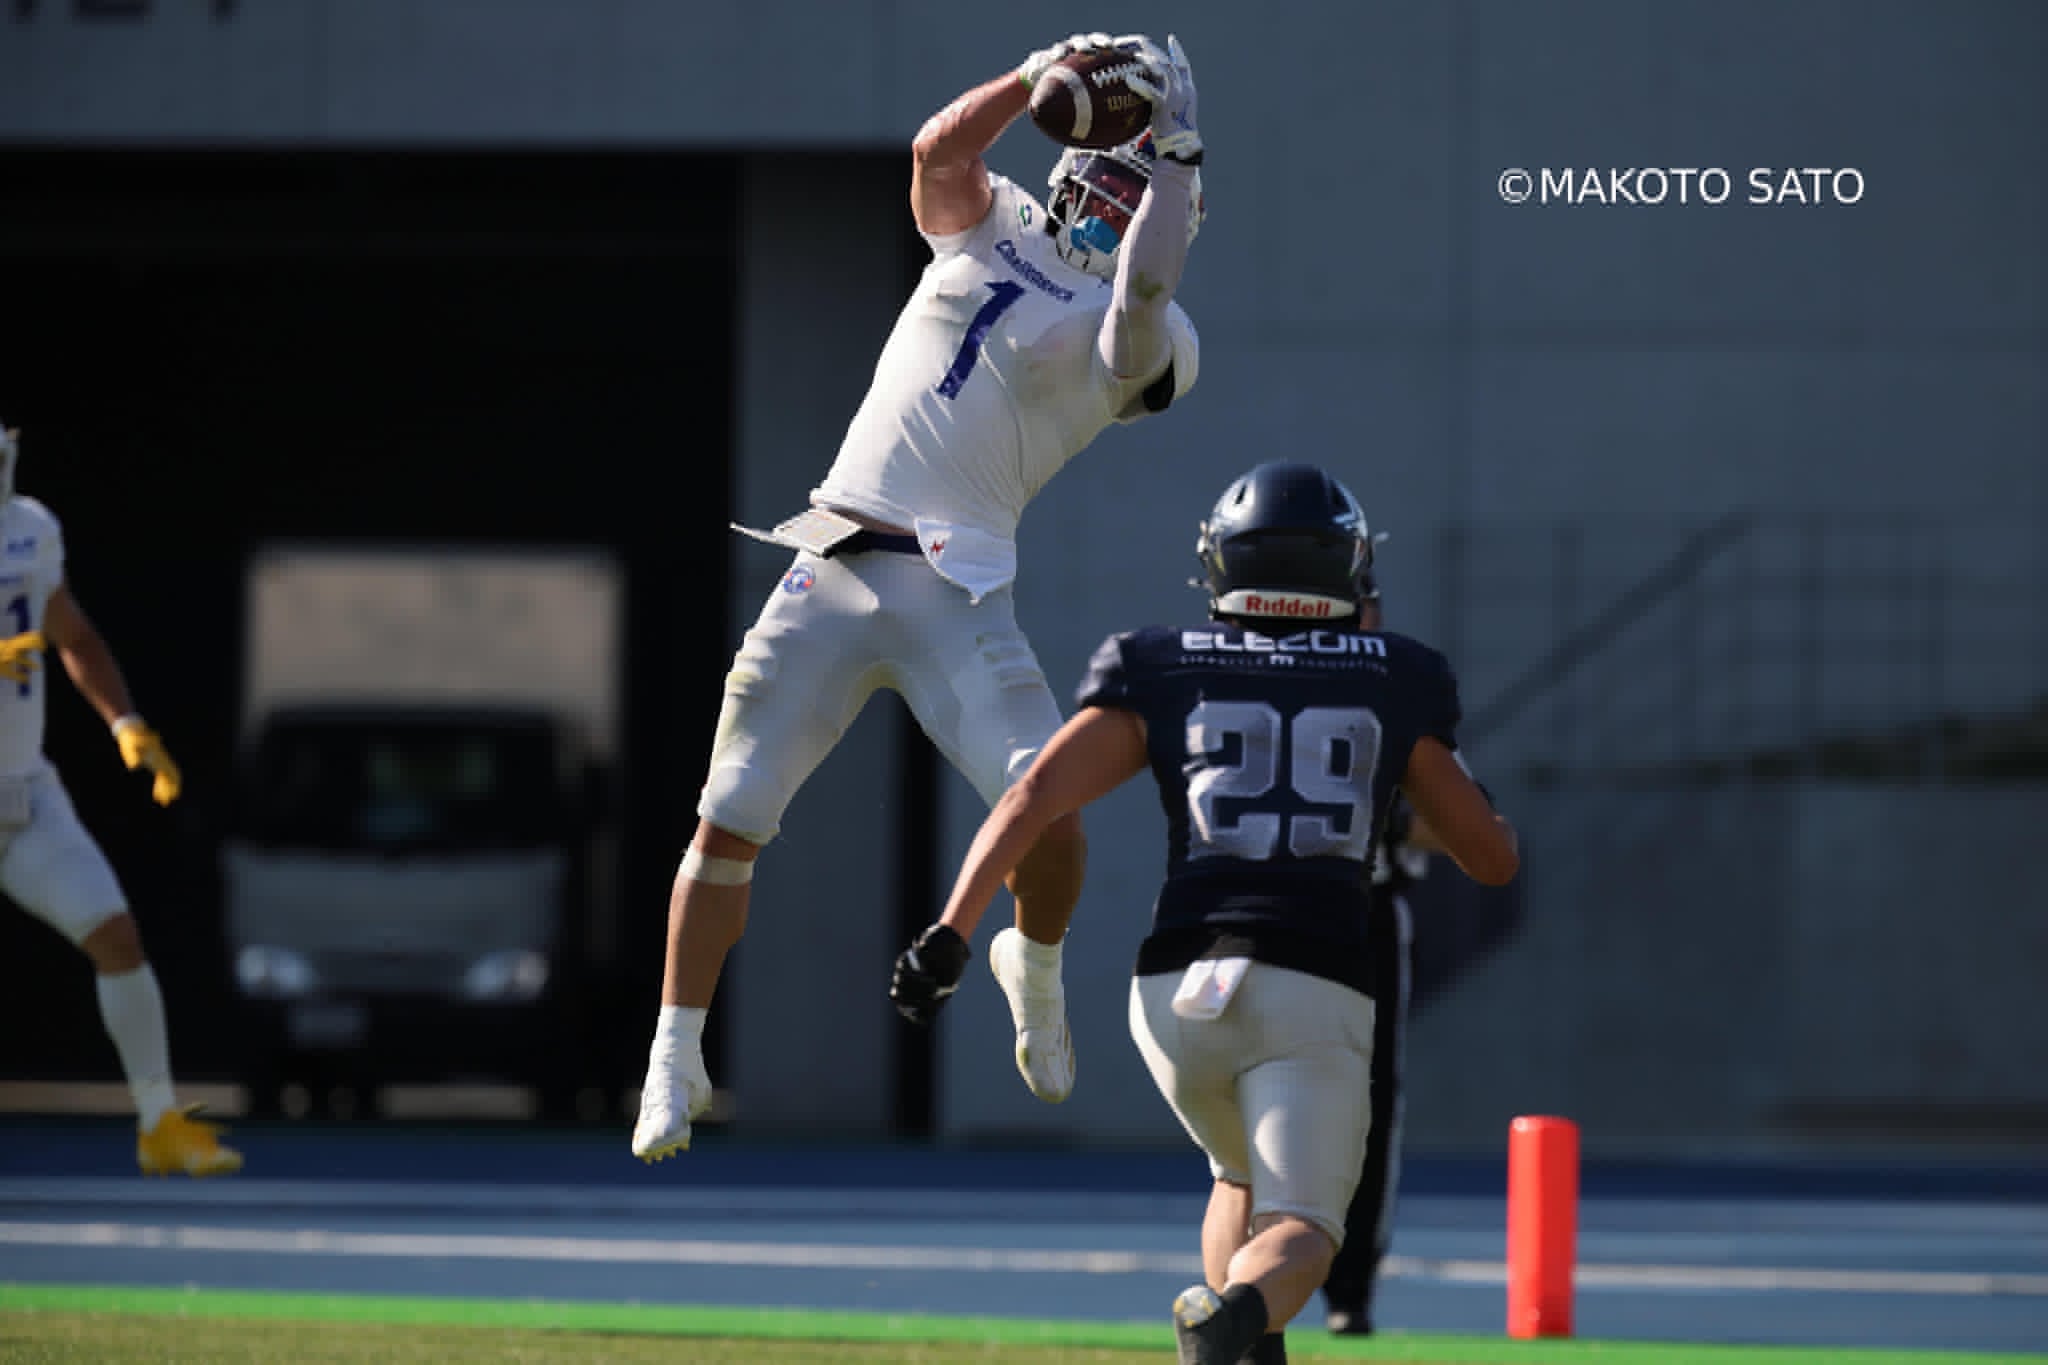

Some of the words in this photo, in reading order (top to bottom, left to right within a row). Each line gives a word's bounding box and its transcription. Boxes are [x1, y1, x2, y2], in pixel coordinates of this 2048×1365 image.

[937, 279, 1026, 401] 1
[1181, 629, 1388, 658] ELECOM
[1245, 595, 1332, 618] Riddell
[1185, 700, 1383, 864] 29
